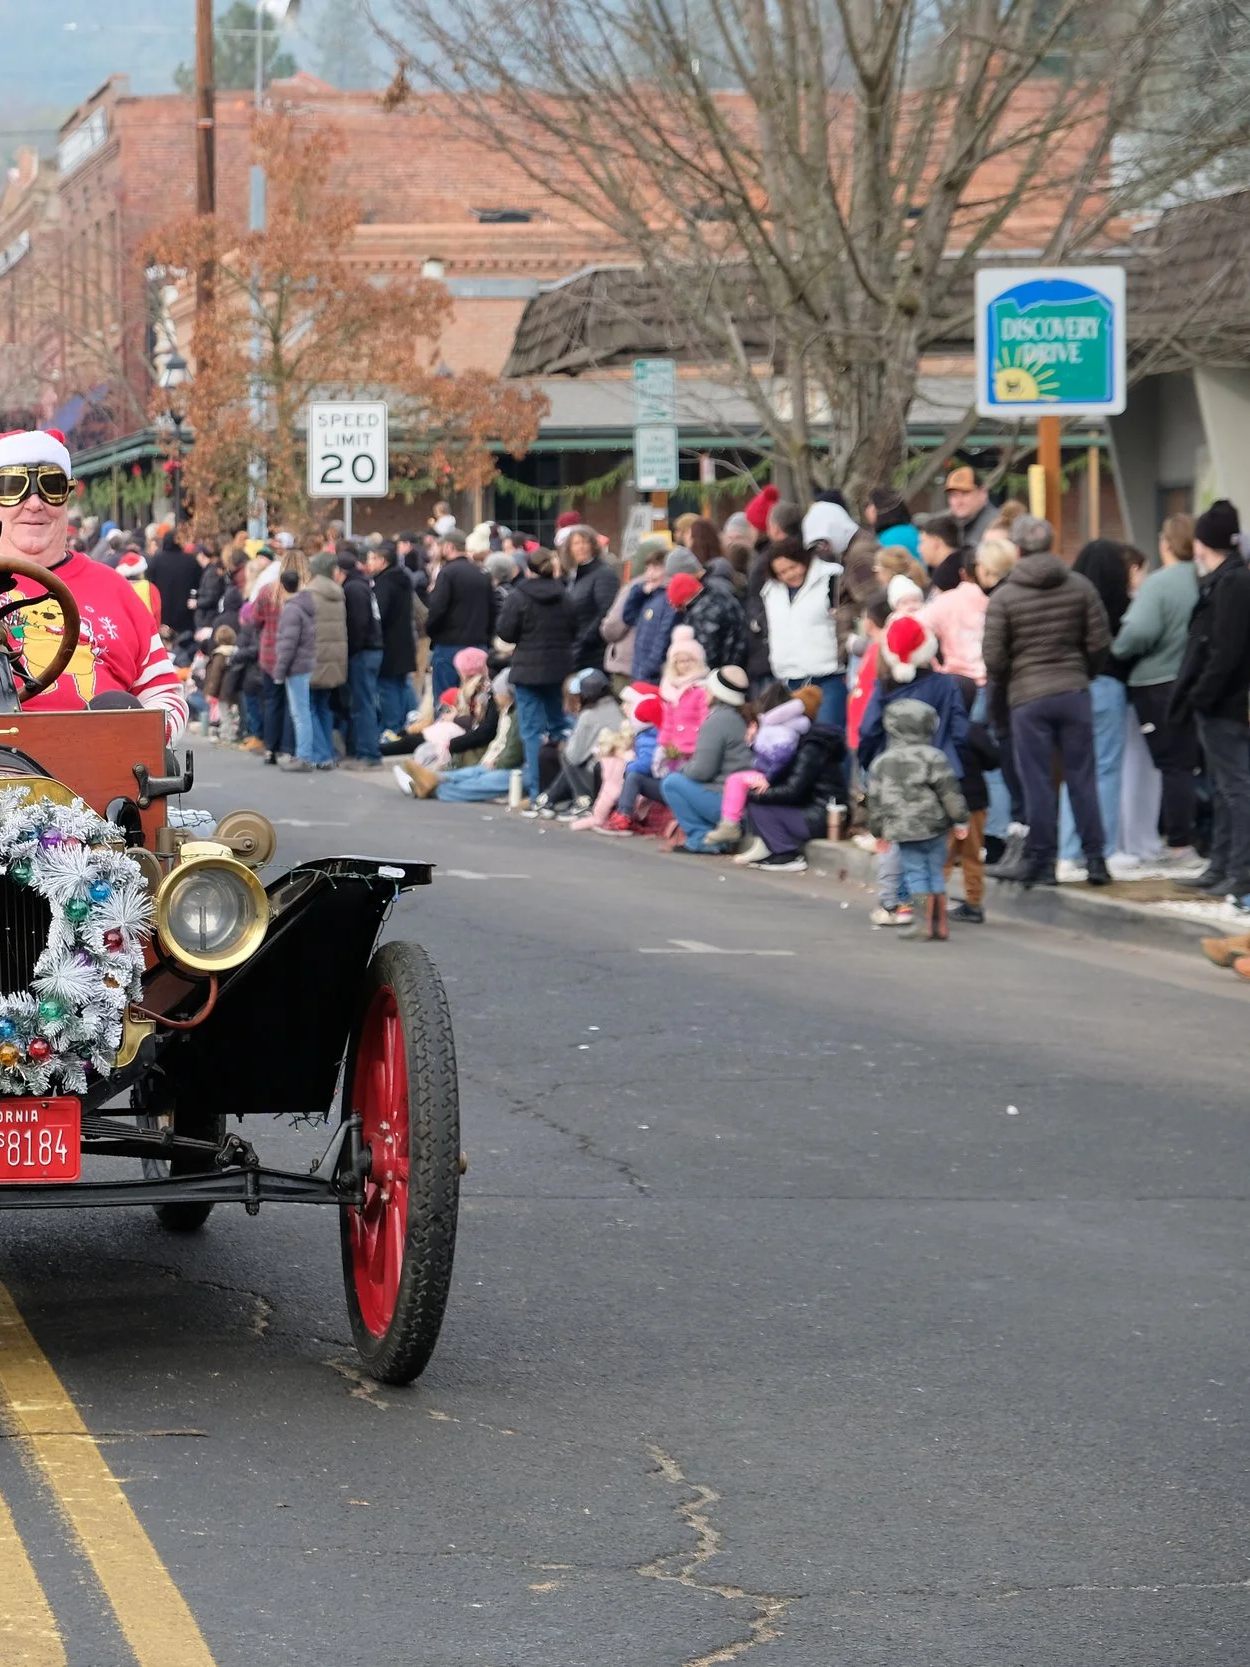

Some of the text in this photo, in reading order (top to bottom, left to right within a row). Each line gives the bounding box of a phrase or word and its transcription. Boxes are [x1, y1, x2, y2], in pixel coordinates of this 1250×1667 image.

[1000, 316, 1102, 341] DISCOVERY
[1021, 341, 1084, 365] DRIVE
[317, 412, 380, 428] SPEED
[324, 432, 372, 447] LIMIT
[320, 453, 376, 484] 20
[7, 1128, 68, 1167] 8184
